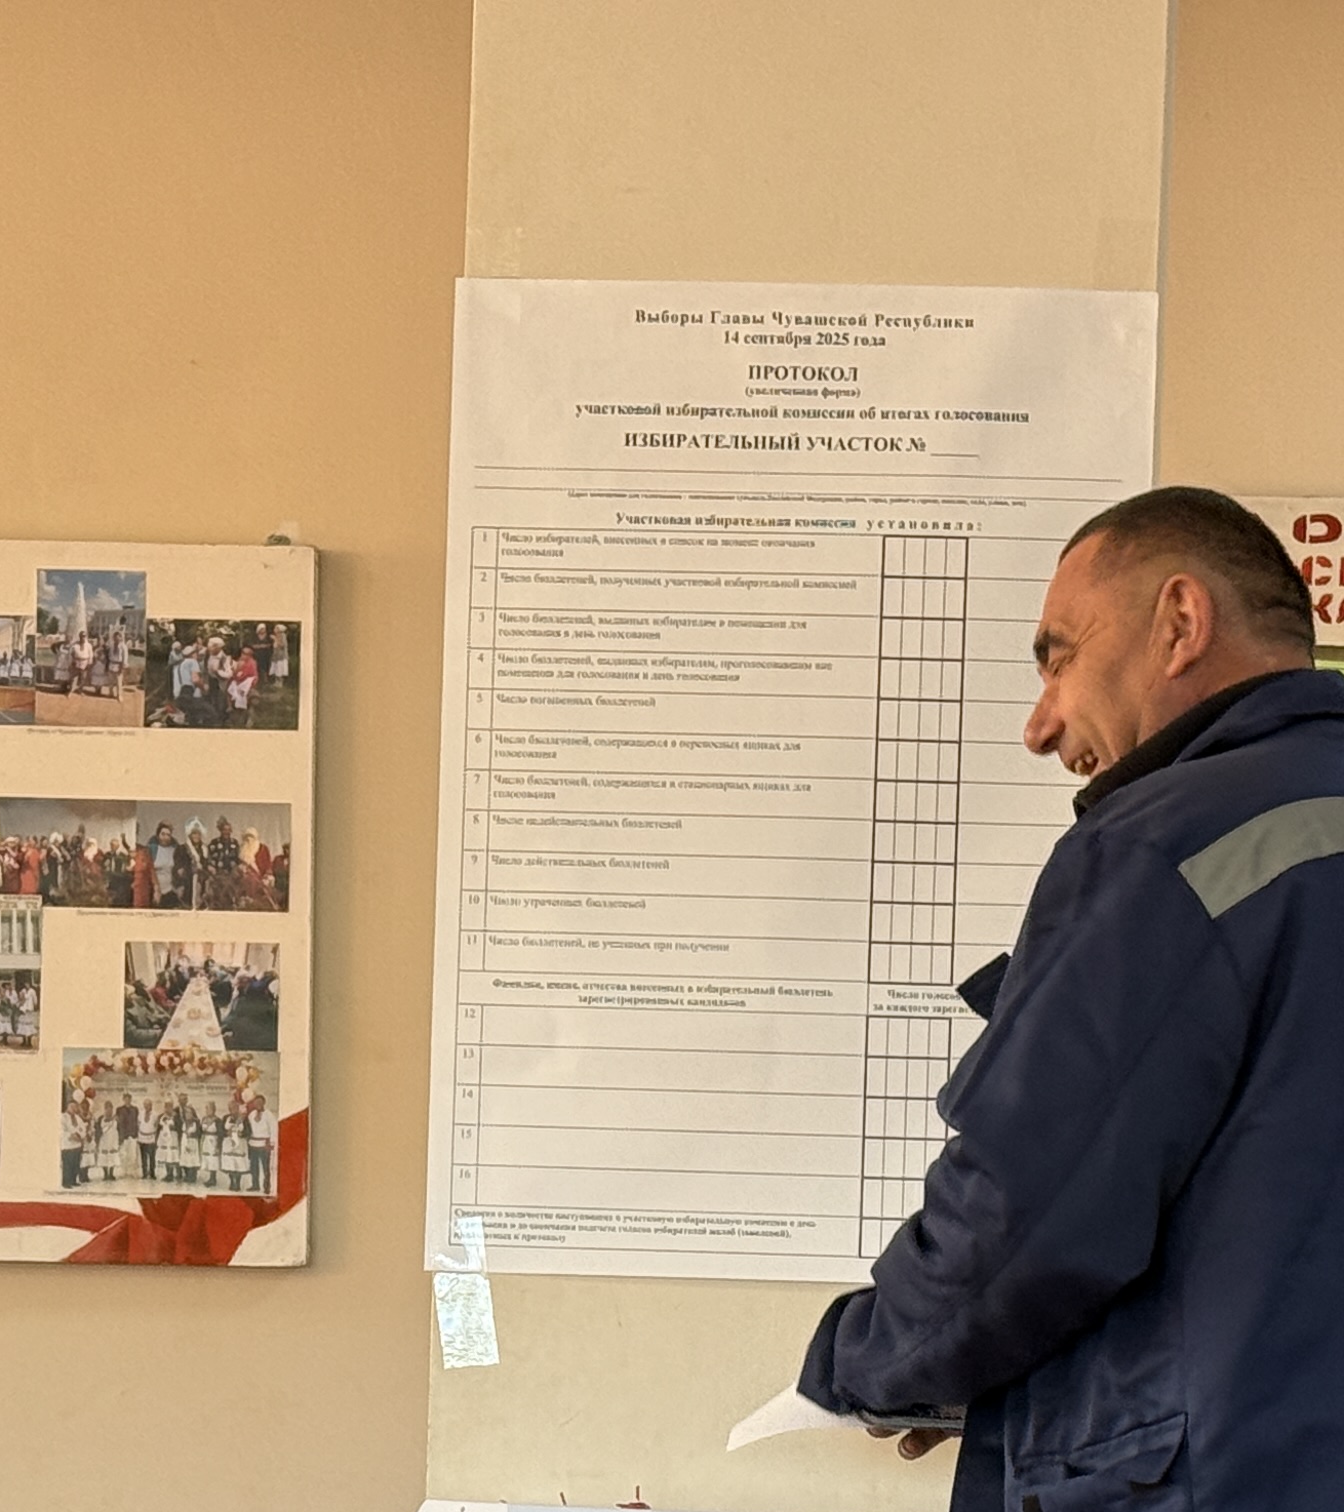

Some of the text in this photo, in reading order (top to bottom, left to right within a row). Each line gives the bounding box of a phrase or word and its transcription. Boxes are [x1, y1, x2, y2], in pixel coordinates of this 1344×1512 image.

[635, 310, 974, 331] Выборы Главы Чувашской Республики
[724, 331, 886, 348] 14 сентября 2025 года
[748, 365, 858, 381] ПРОТОКОЛ
[575, 403, 1029, 423] участковой избирательной комиссии об итогах голосования
[624, 432, 926, 452] ИЗБИРАТЕЛЬНЫЙ УЧАСТОК №
[616, 512, 691, 528] Участковая
[695, 514, 791, 529] избирательная
[795, 517, 856, 528] комиссия
[480, 573, 487, 582] 2
[477, 654, 484, 663] 4
[475, 734, 482, 744] 6
[474, 774, 480, 784] 7
[473, 814, 480, 824] 8
[471, 855, 478, 865] 9
[468, 894, 480, 904] 10
[466, 935, 477, 945] 11
[464, 1008, 476, 1018] 12
[462, 1049, 474, 1058] 13
[461, 1088, 473, 1099] 14
[460, 1129, 472, 1139] 15
[458, 1169, 471, 1179] 16
